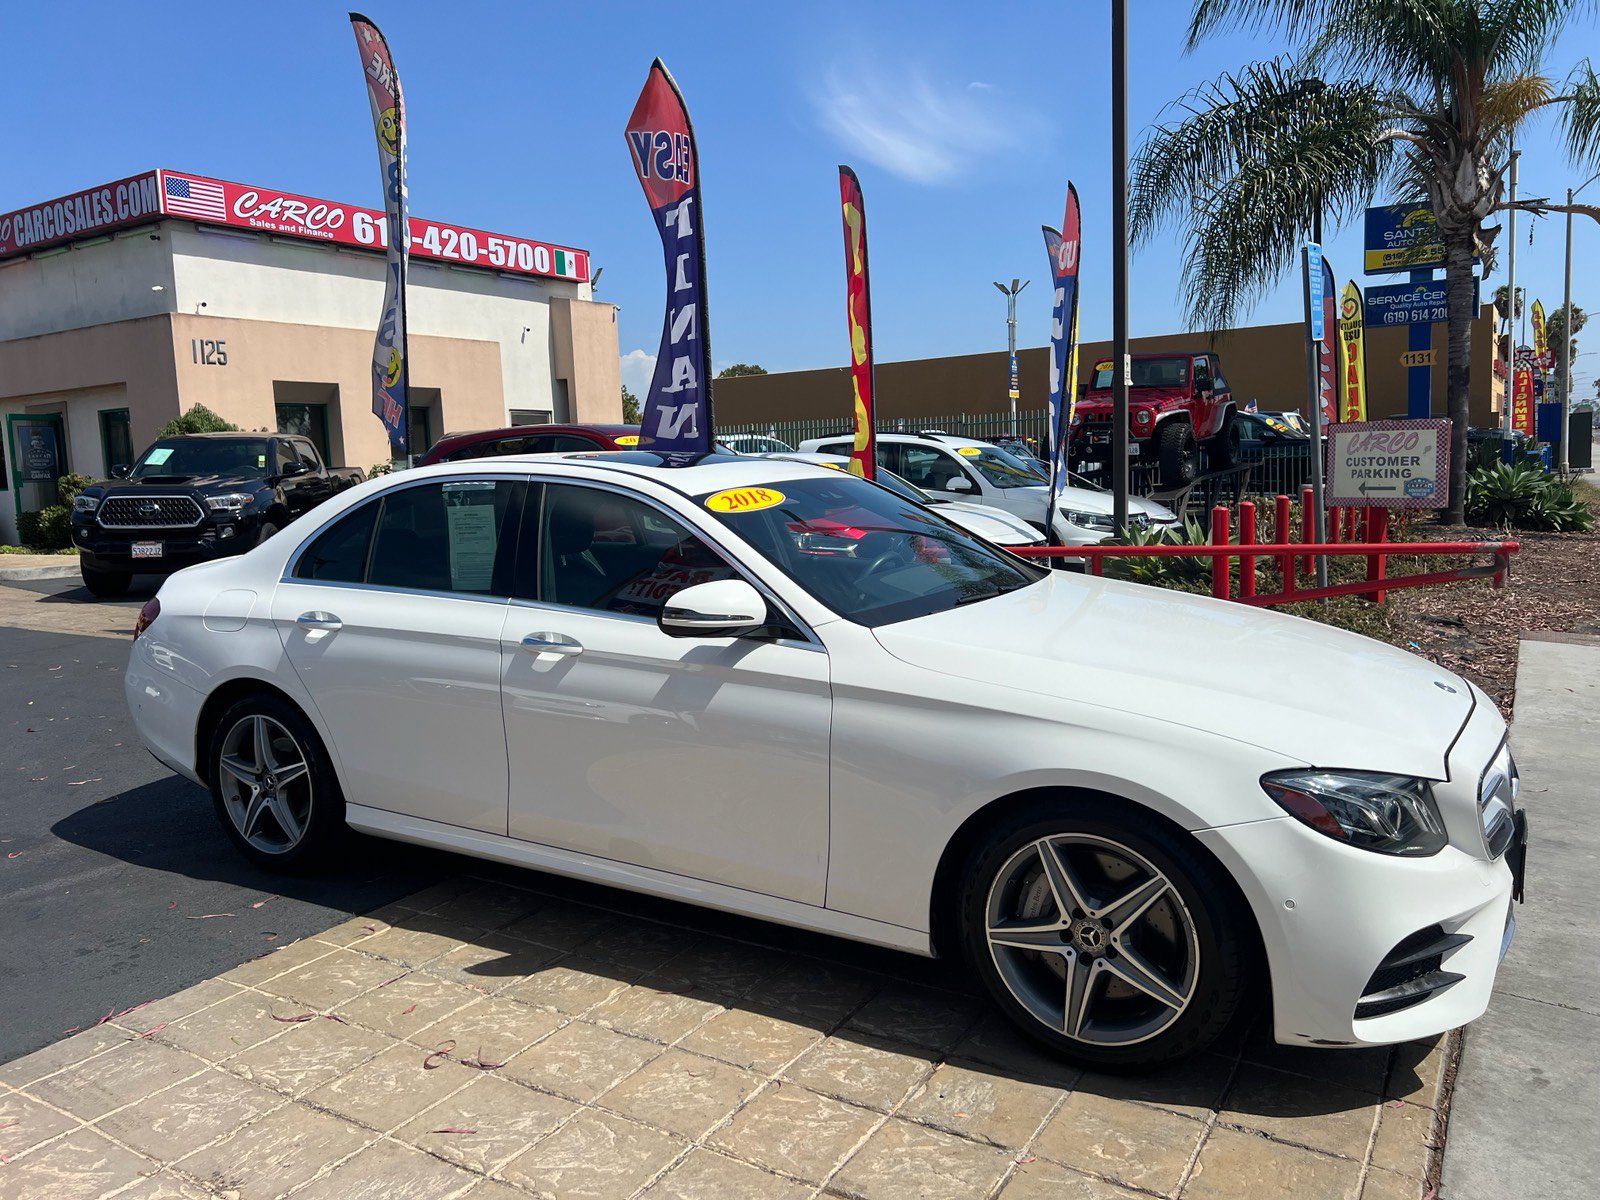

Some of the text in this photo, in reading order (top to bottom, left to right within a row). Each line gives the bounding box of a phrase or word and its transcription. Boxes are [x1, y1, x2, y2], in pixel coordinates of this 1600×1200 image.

[13, 176, 158, 247] CARCOSALES.COM
[233, 191, 345, 229] CARCO
[249, 217, 334, 238] Sales and Finance
[1383, 228, 1426, 240] SANT
[352, 211, 550, 274] 61-420-5700
[1386, 239, 1415, 248] AUTO
[1368, 290, 1447, 305] SERVICE CEN
[1383, 311, 1409, 323] (619)
[1411, 309, 1429, 320] 614
[191, 338, 228, 366] 1125
[1403, 353, 1431, 364] 1131
[1346, 431, 1420, 455] CARCO
[1346, 456, 1421, 467] CUSTOMER
[1351, 468, 1412, 479] PARKING
[720, 489, 772, 510] 2018
